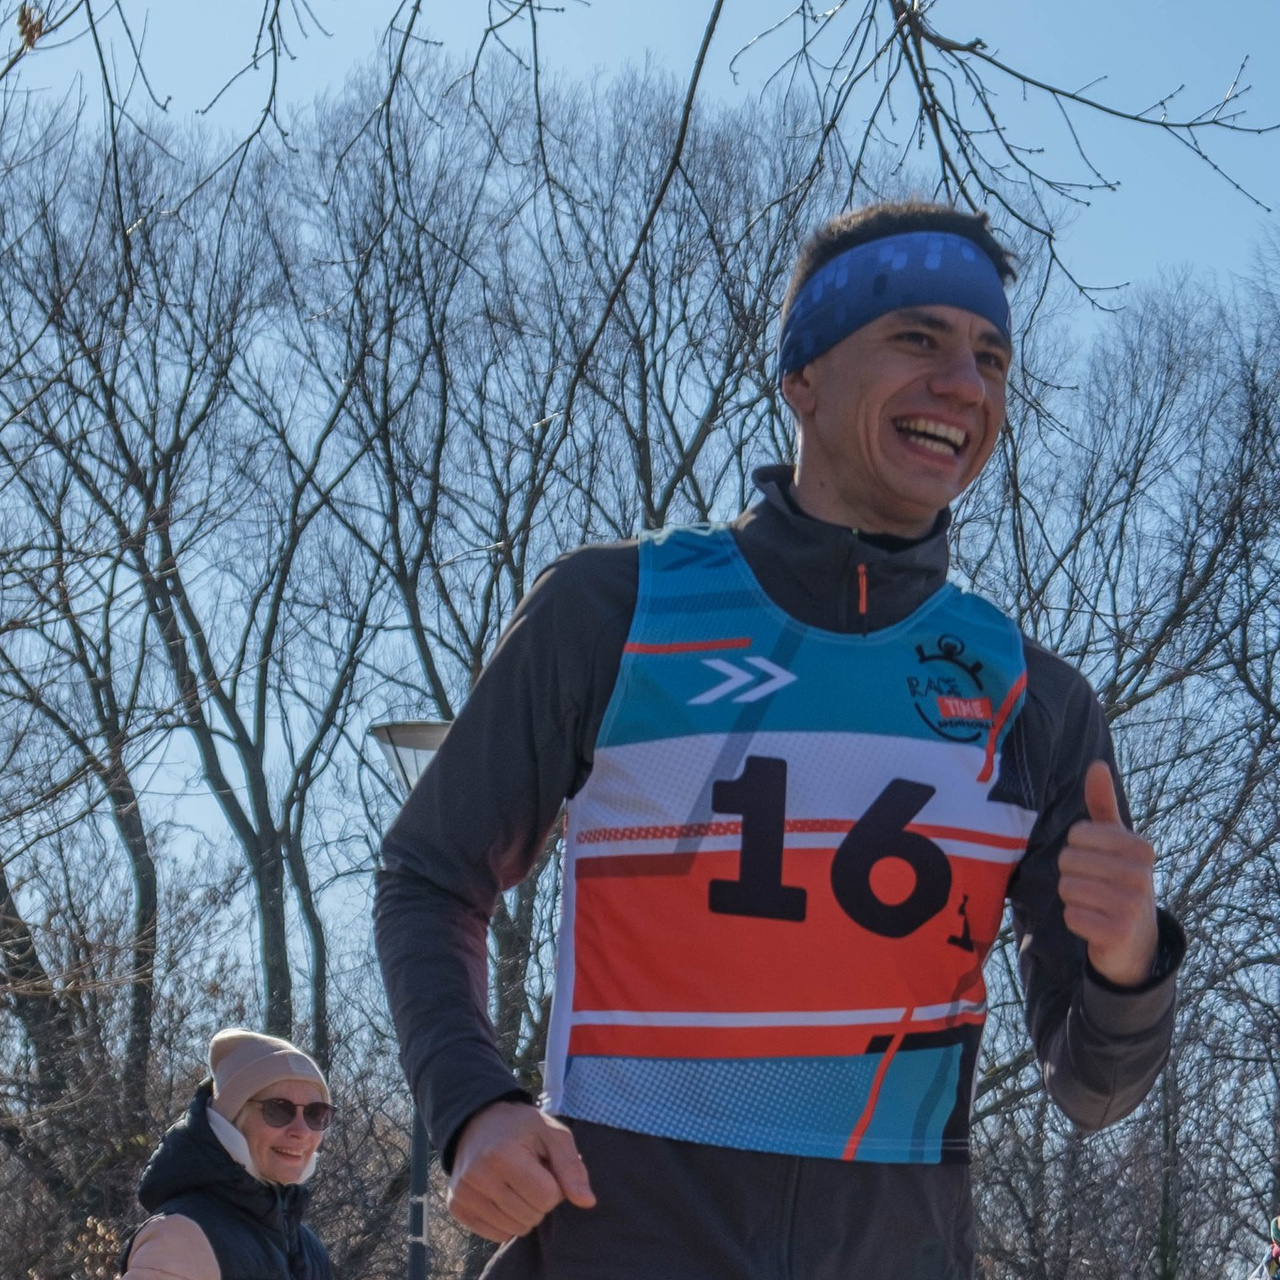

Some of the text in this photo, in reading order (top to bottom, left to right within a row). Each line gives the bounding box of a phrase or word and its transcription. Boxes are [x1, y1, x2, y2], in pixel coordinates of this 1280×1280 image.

[906, 676, 963, 698] RACE
[944, 698, 985, 719] TIME
[708, 755, 953, 938] 16
